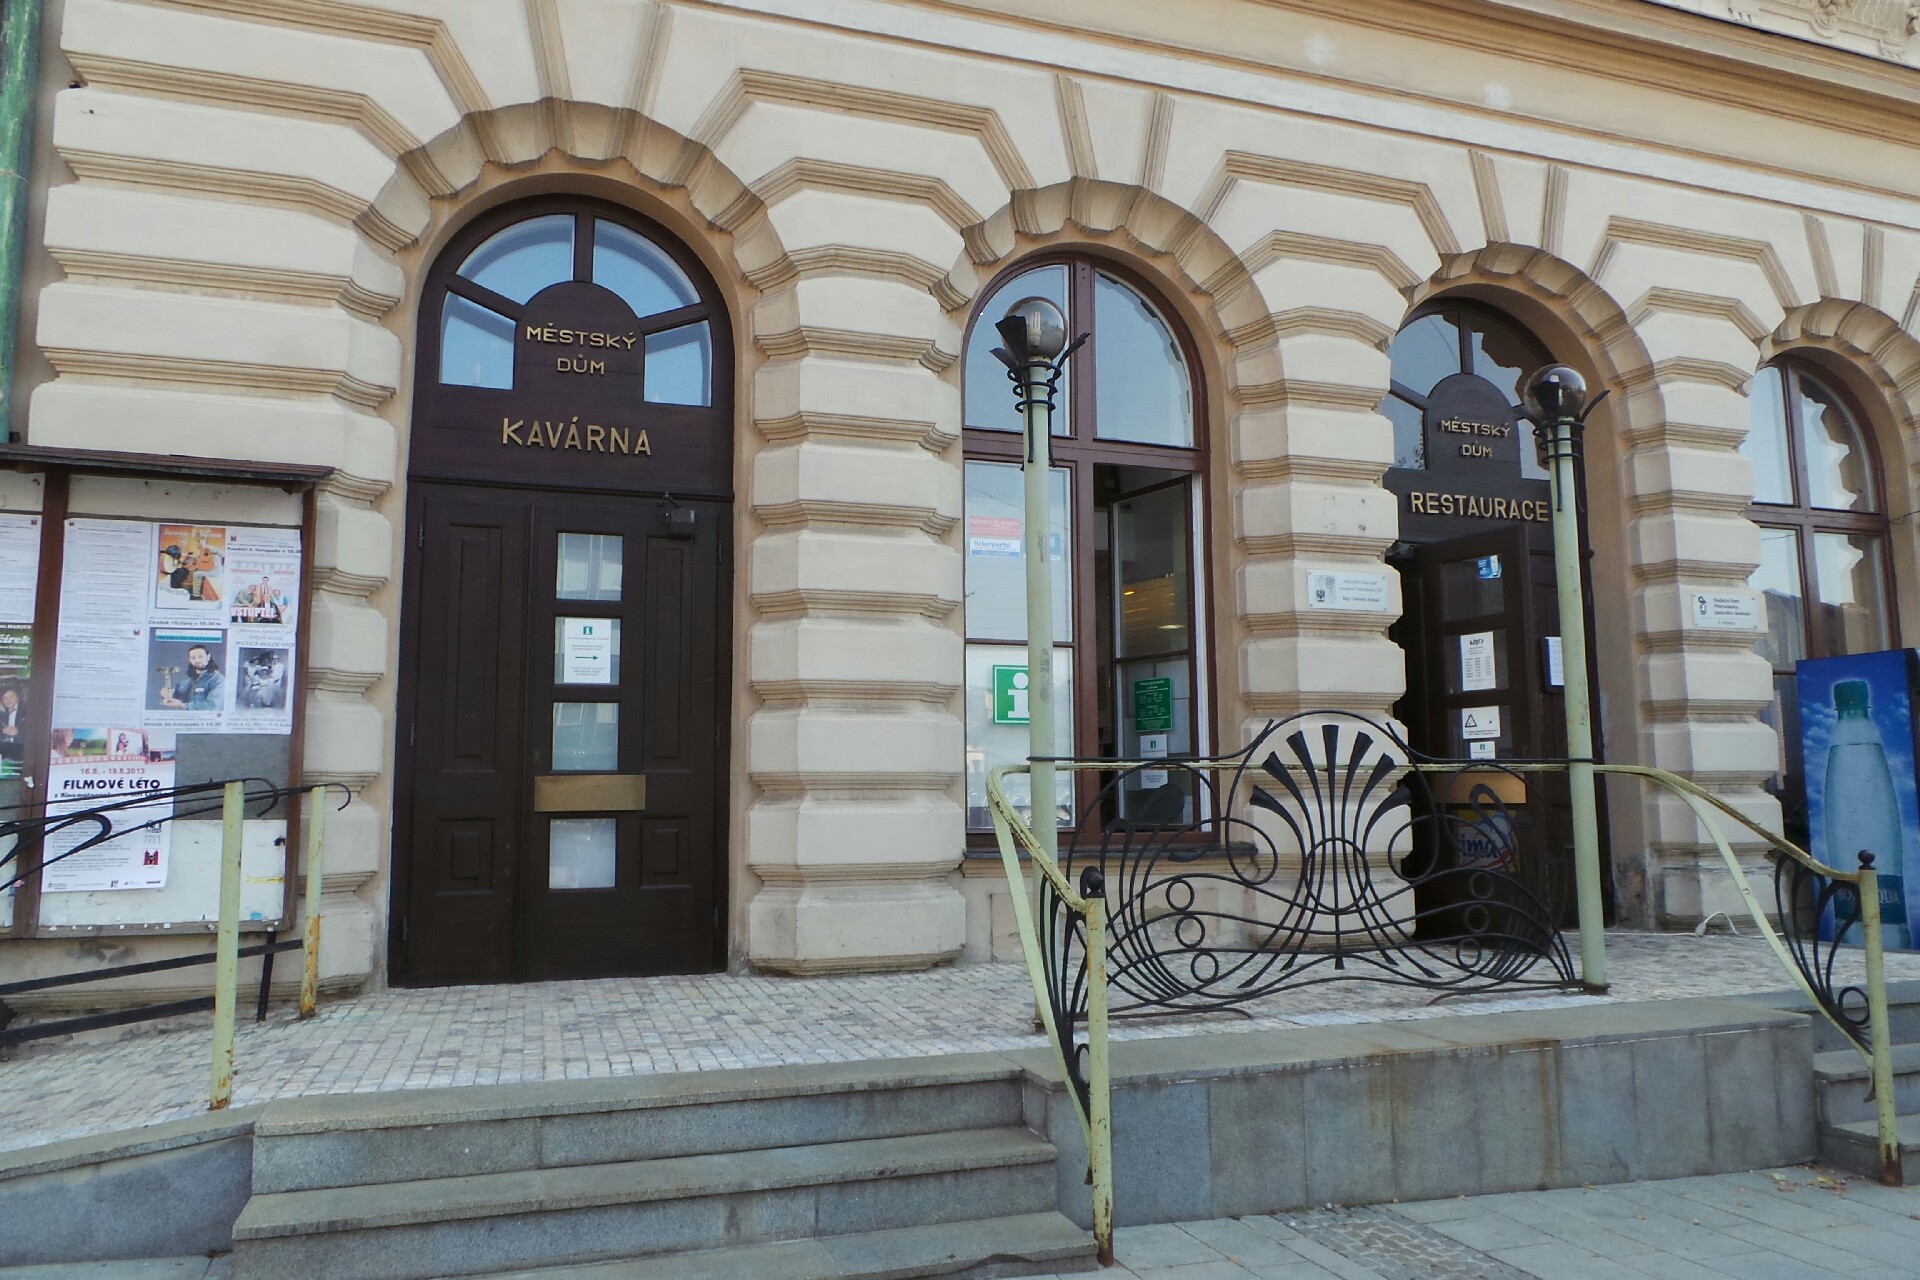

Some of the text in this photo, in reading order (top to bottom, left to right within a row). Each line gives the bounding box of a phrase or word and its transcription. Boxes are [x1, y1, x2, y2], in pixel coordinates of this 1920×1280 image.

[526, 322, 637, 350] MĚSTSKÝ
[557, 353, 606, 375] DŮM
[502, 416, 652, 456] KAVÁRNA
[1441, 416, 1510, 438] MĚSTSKÝ
[1462, 440, 1493, 458] DŮM
[1411, 491, 1549, 522] RESTAURACE
[63, 777, 161, 789] FILMOVÉ LÉTO
